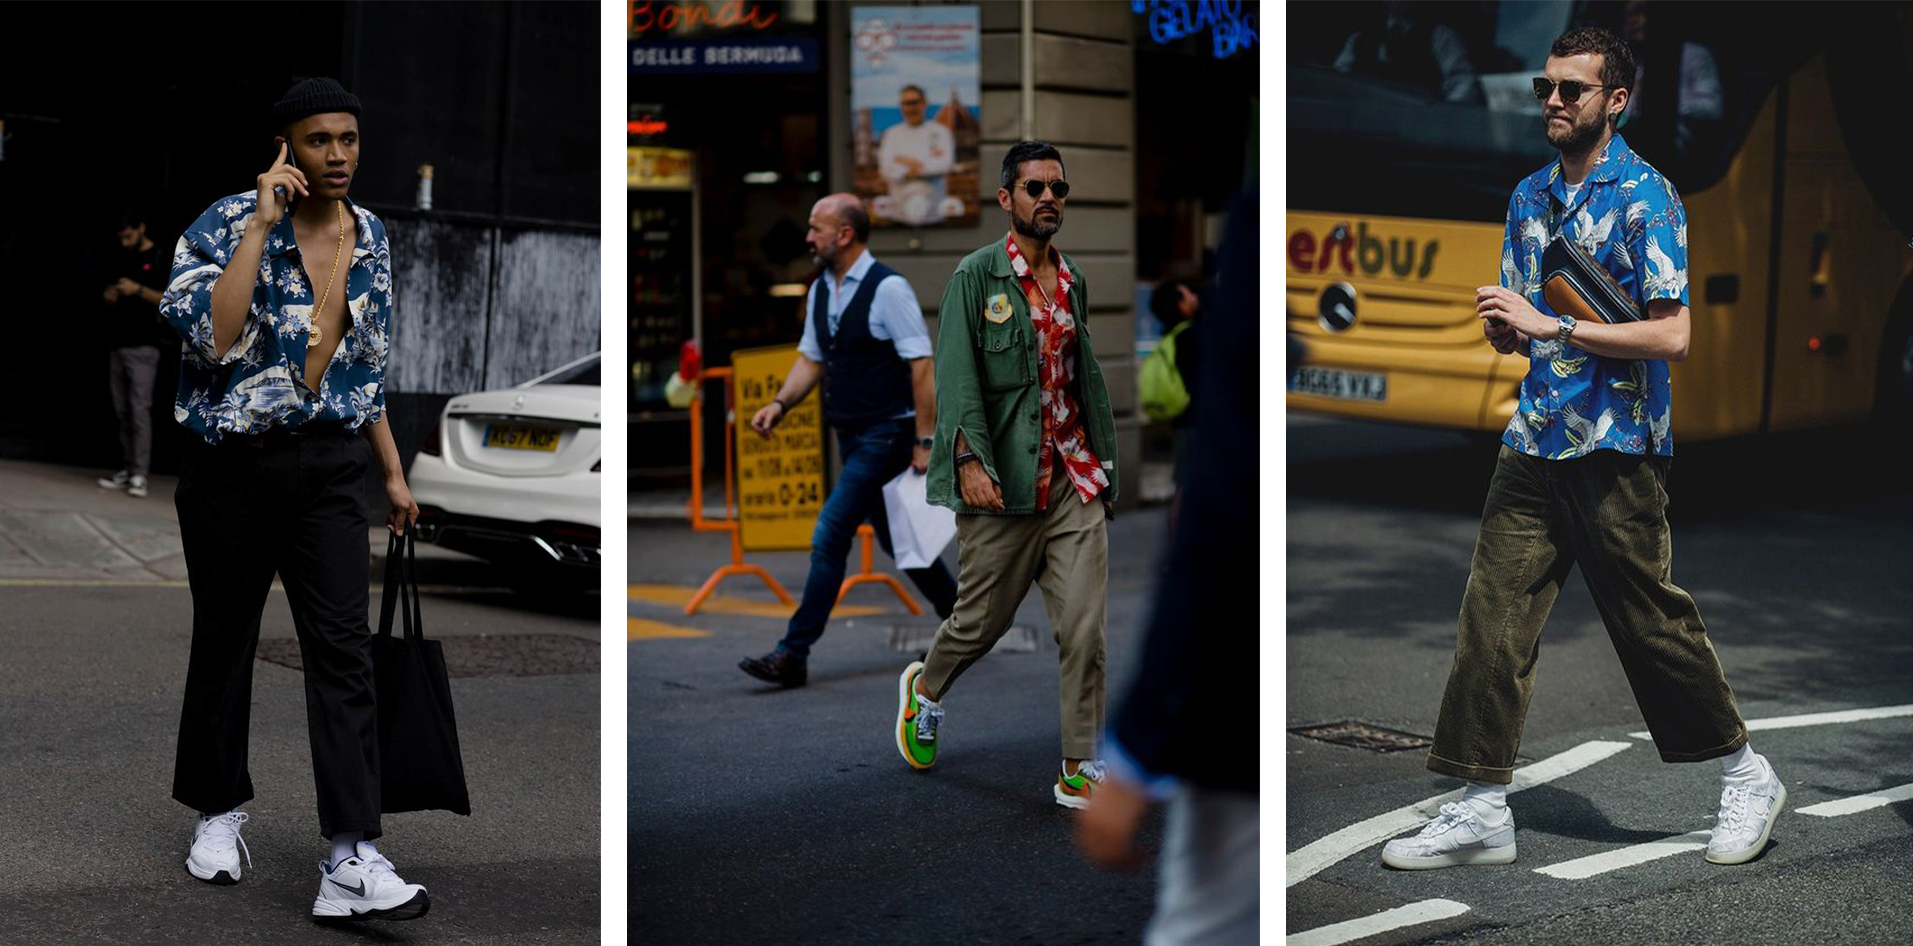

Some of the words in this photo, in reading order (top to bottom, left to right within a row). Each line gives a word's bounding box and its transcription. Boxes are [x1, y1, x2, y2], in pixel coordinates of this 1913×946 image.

[632, 48, 696, 66] DELLE
[704, 46, 803, 65] BERMUDA
[1287, 221, 1439, 279] estbus
